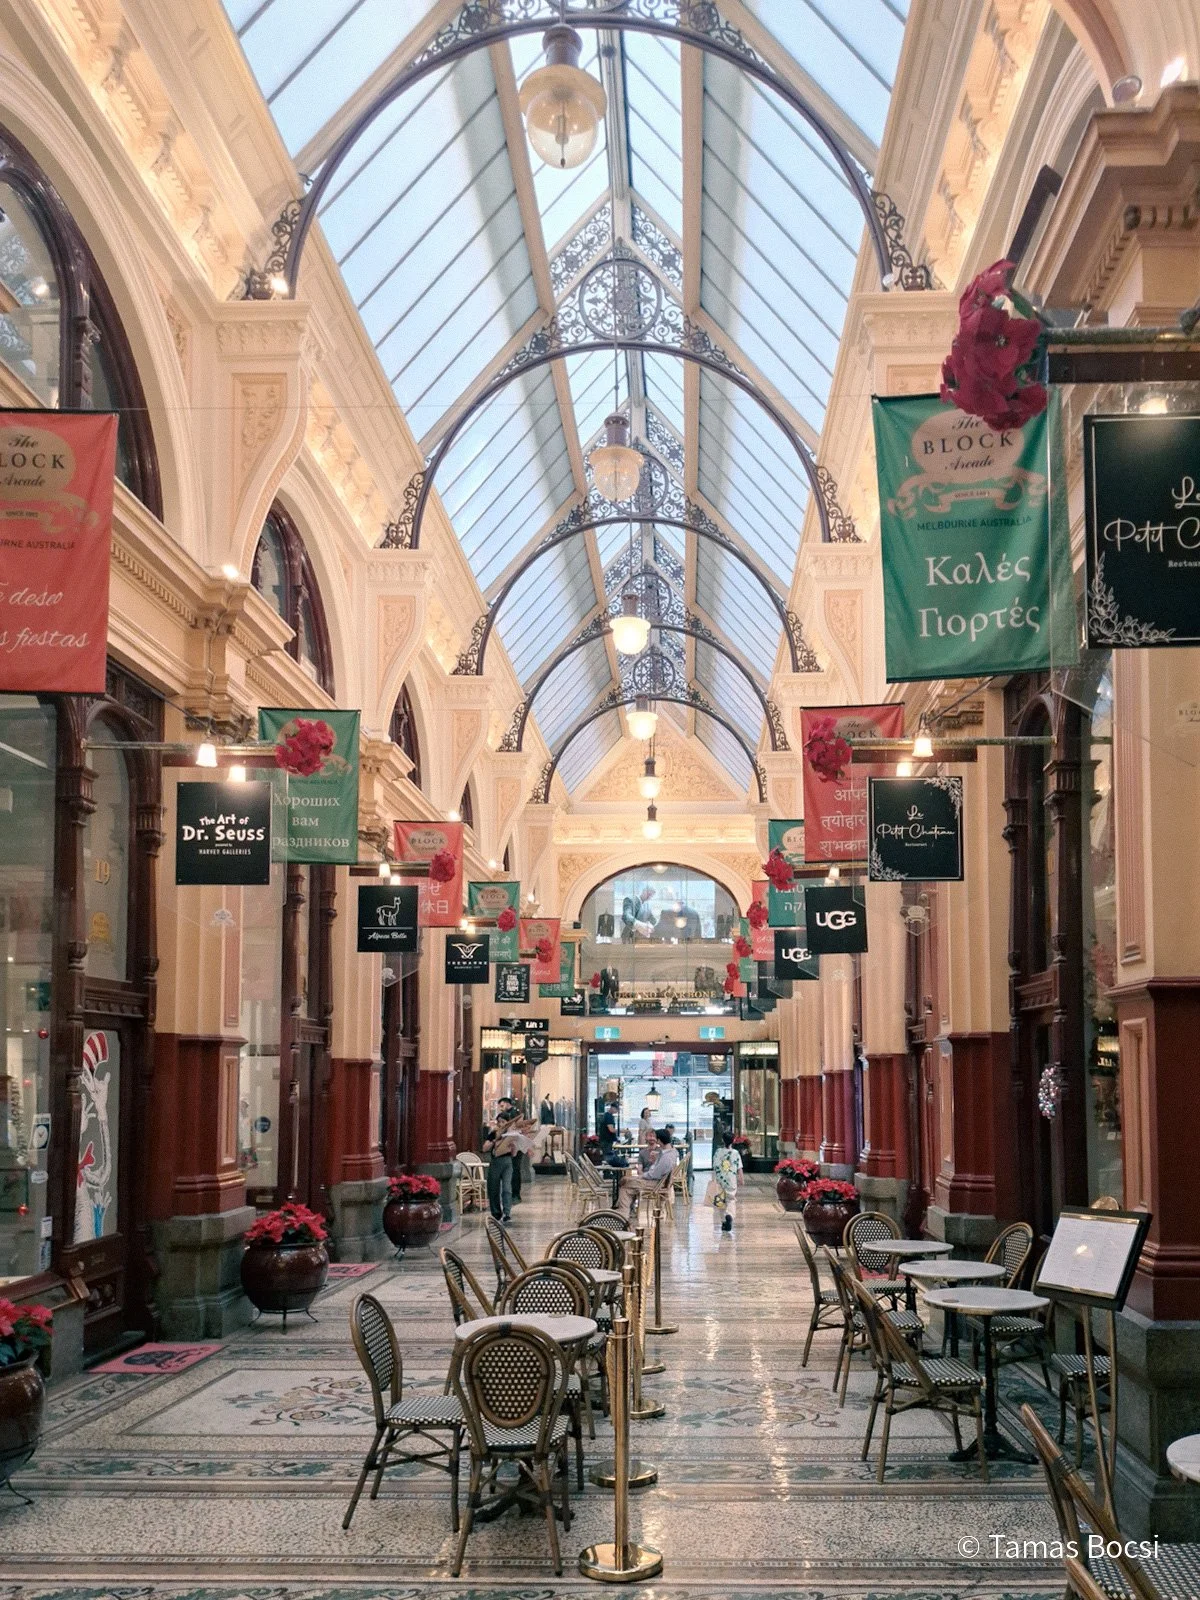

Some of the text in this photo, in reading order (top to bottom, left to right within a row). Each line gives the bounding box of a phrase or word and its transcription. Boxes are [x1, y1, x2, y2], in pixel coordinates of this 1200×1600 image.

[952, 416, 982, 430] The
[8, 434, 38, 448] The
[923, 431, 1014, 454] BLOCK
[0, 452, 65, 469] LOCK
[945, 456, 994, 471] Arcade
[917, 515, 1032, 531] MELBOURNE AUSTRALIA
[1103, 517, 1178, 552] Petit
[26, 541, 75, 550] AUSTRALIA
[925, 551, 1031, 587] Καλές
[918, 596, 1041, 642] Γιορτές
[6, 626, 91, 654] fiestas
[844, 720, 860, 729] The
[272, 792, 341, 810] Хороших
[199, 813, 250, 826] The Art of
[291, 816, 320, 827] вам
[182, 825, 265, 841] Dr. Seuss
[876, 822, 956, 839] Petit Chateau
[271, 836, 350, 851] раздников
[815, 910, 857, 930] UGG
[782, 947, 812, 962] UGG
